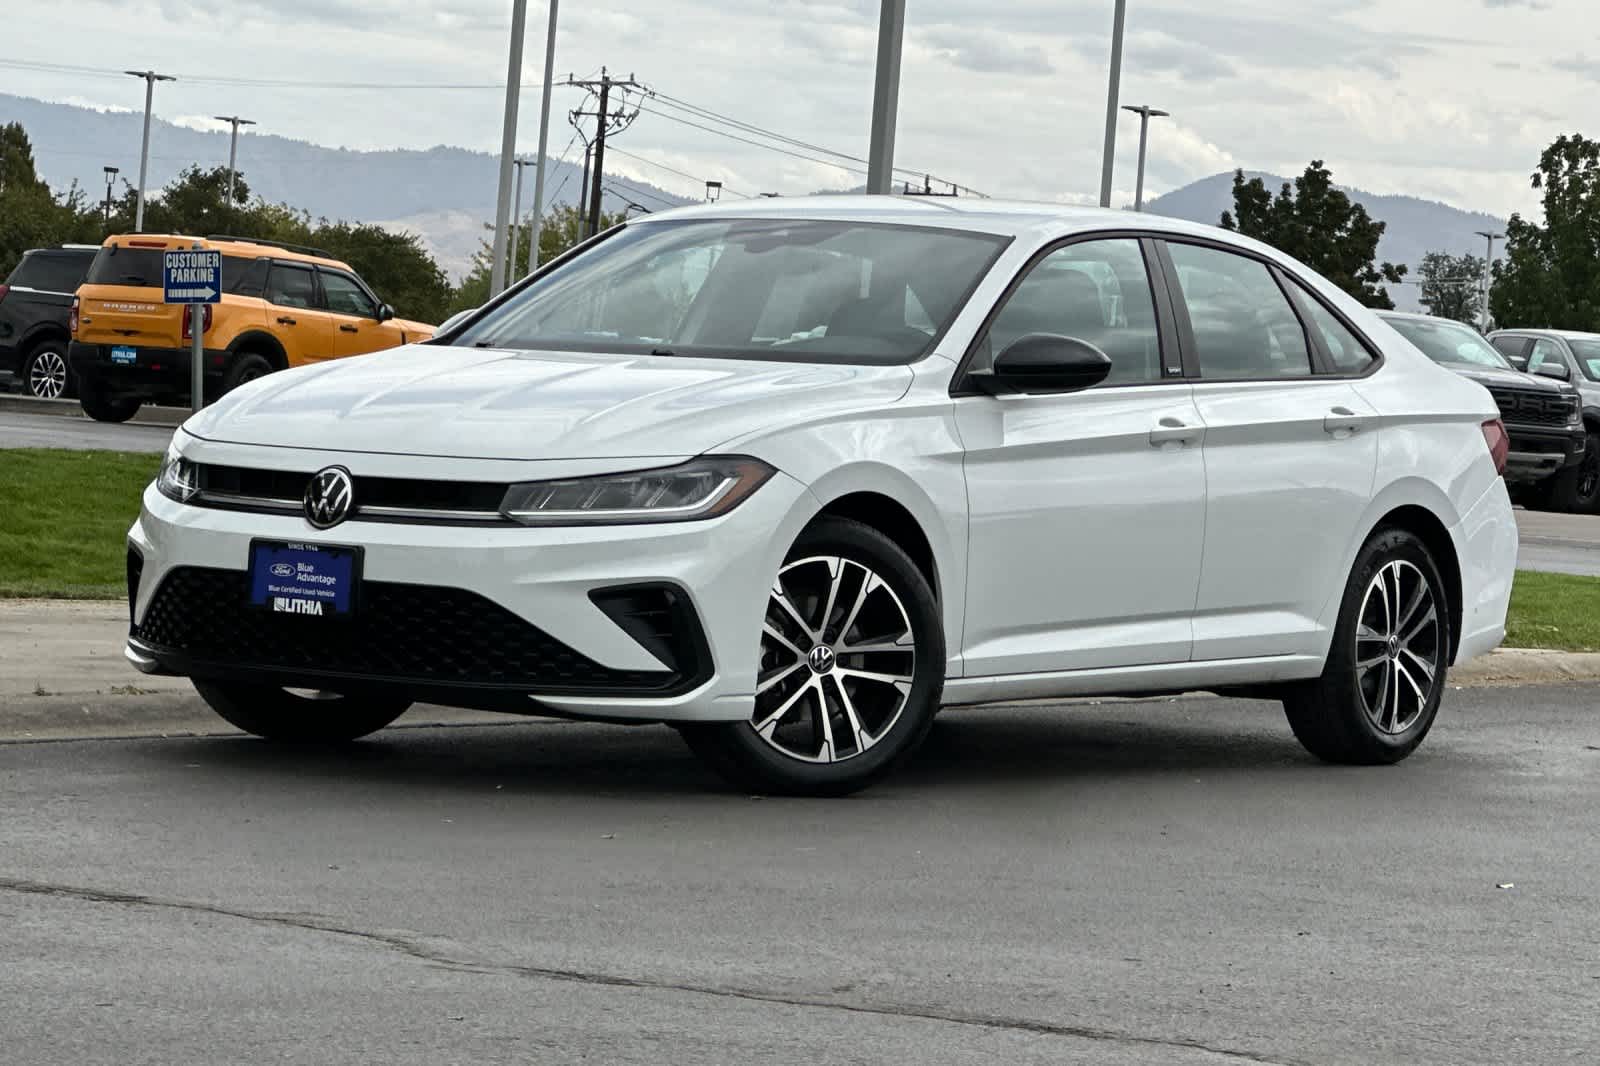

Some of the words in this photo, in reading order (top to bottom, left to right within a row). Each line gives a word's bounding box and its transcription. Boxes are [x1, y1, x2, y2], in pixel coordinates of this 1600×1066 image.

[166, 253, 219, 268] CUSTOMER
[170, 268, 214, 283] PARKING
[297, 562, 314, 573] Blue
[296, 572, 337, 586] Advantage
[285, 598, 323, 616] LITHIA
